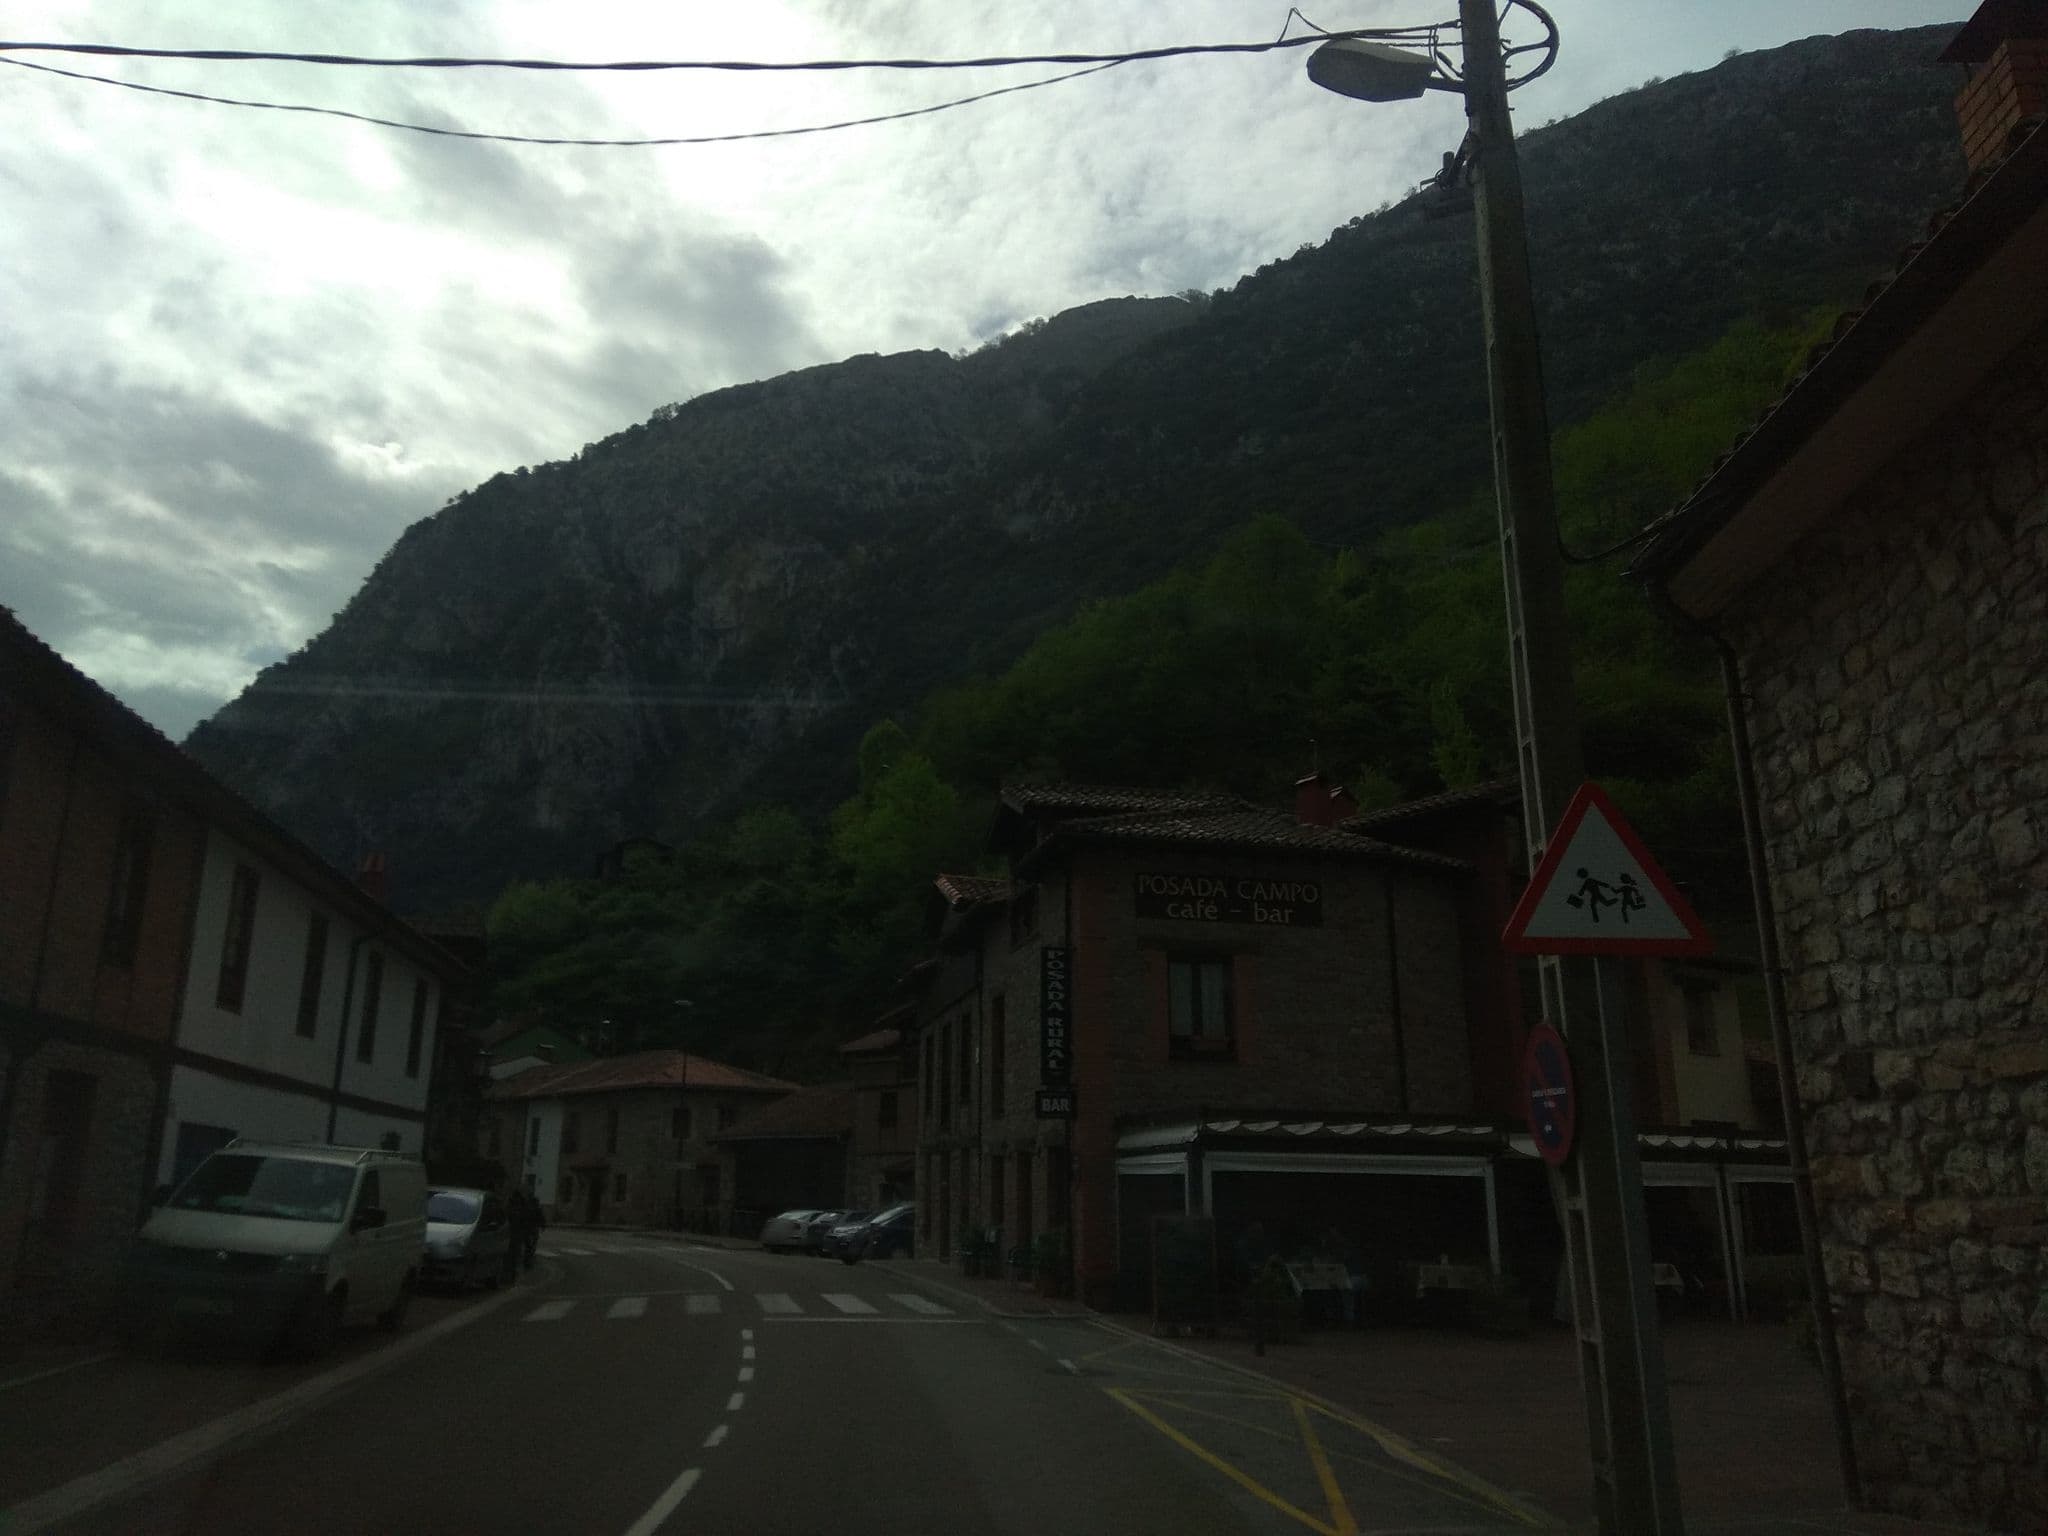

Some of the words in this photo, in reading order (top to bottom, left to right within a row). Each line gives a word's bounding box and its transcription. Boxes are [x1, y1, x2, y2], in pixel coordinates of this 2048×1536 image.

[1138, 875, 1227, 897] POSADA
[1237, 880, 1319, 904] CAMPO
[1254, 901, 1295, 924] bar
[1047, 951, 1065, 1011] POSADA
[1041, 1098, 1071, 1112] BAR
